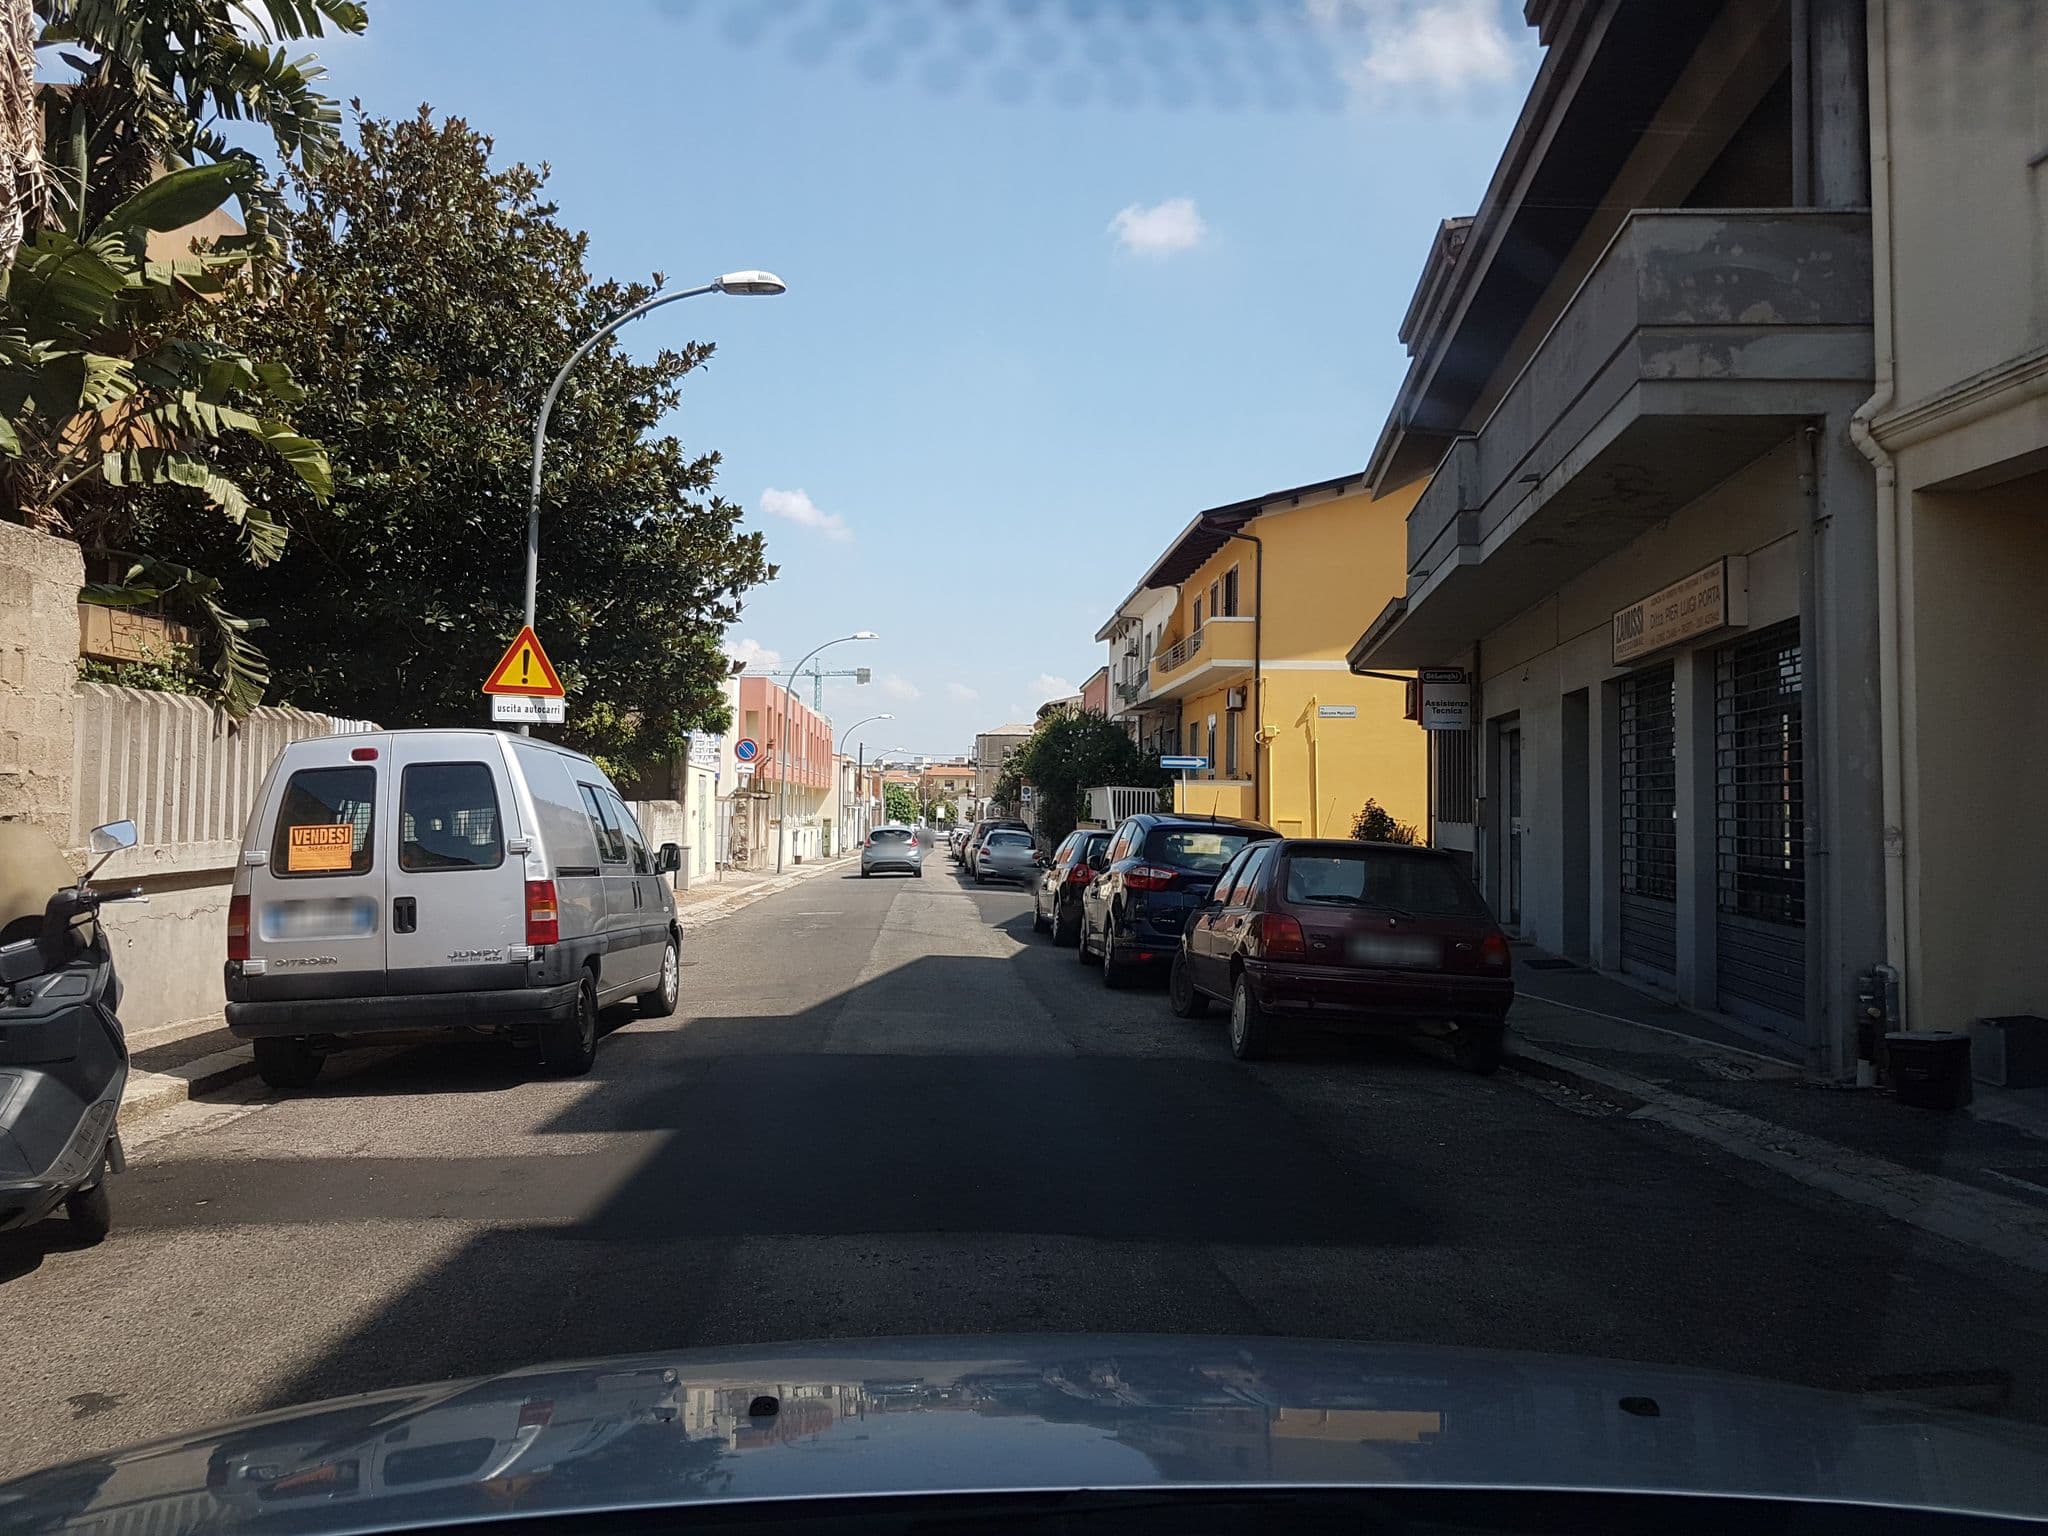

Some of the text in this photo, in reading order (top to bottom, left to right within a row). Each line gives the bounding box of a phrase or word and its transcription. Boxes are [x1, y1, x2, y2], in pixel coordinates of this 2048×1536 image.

[1665, 603, 1679, 623] PIER
[1681, 595, 1697, 617] LUIGI
[1698, 585, 1721, 610] PORTA
[1616, 604, 1643, 645] ZANUSSI
[497, 703, 560, 714] uscita autocarri
[1425, 699, 1469, 707] Assistenza
[1432, 706, 1462, 715] Tecnica
[294, 828, 349, 845] VENDESI
[447, 949, 502, 959] JUMPY
